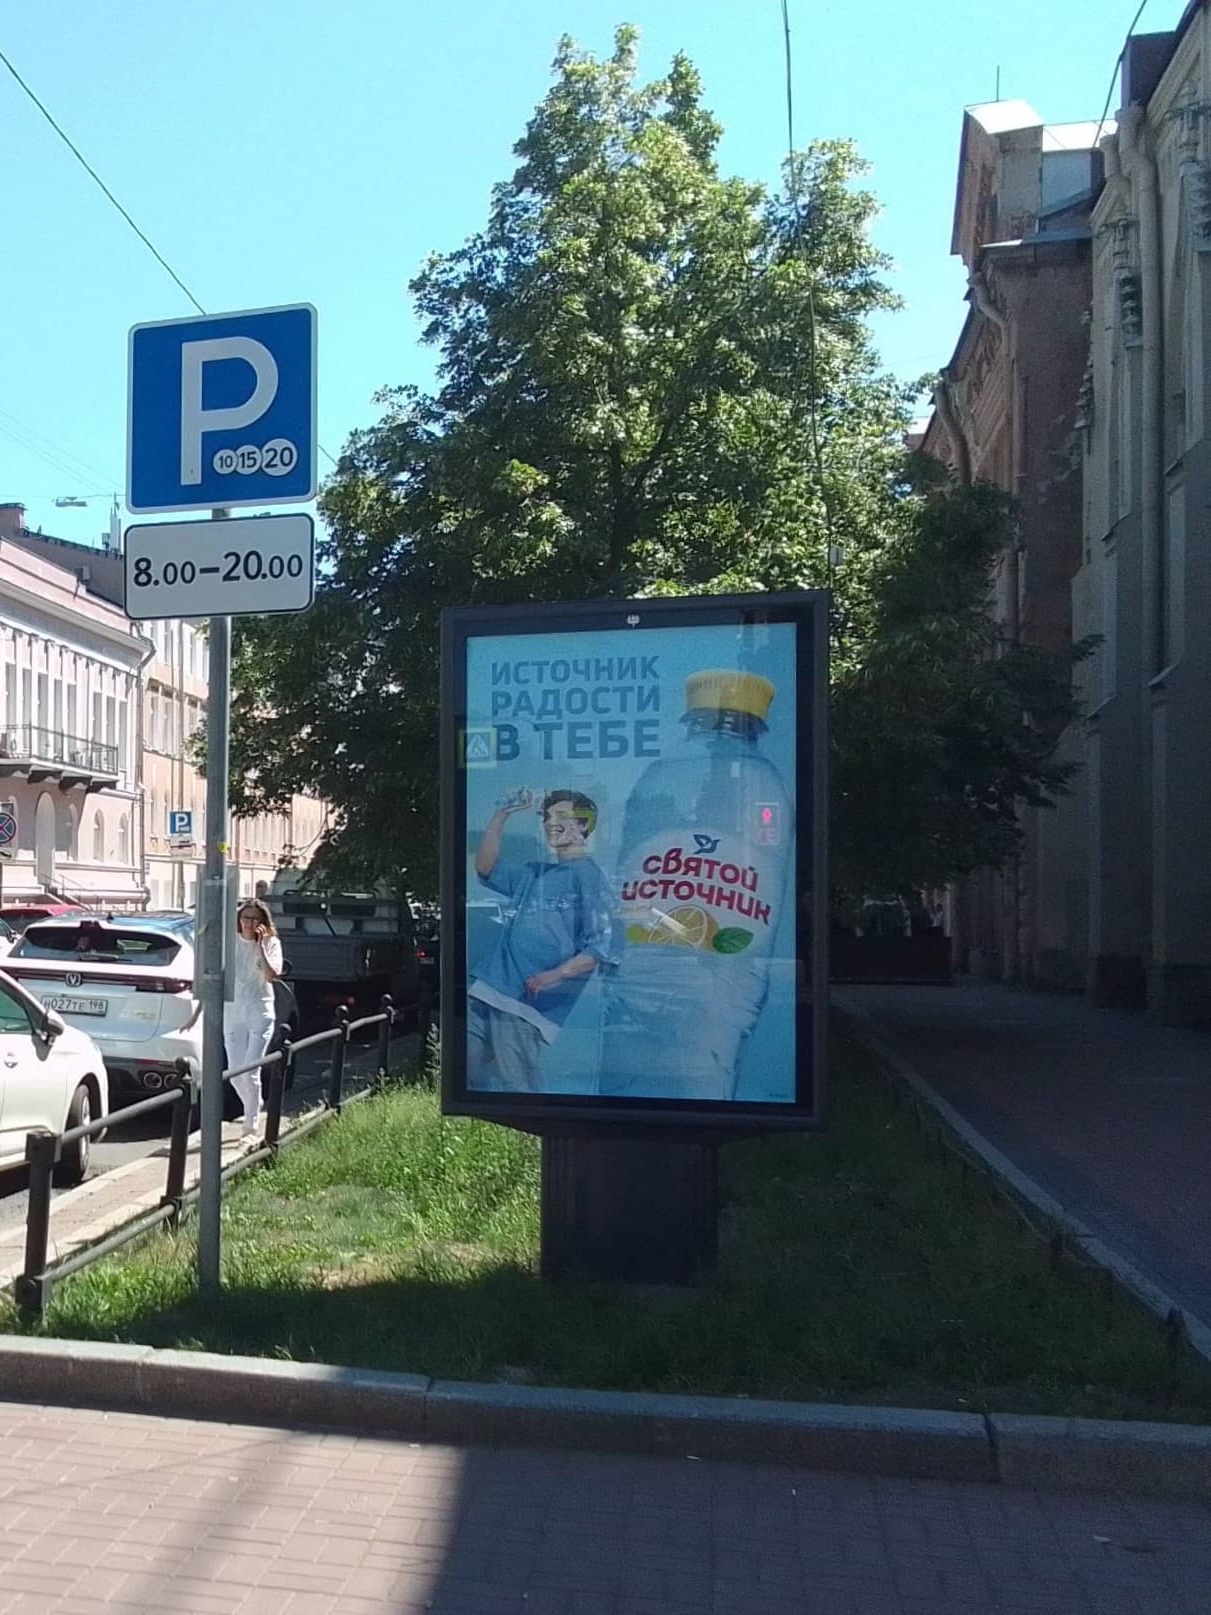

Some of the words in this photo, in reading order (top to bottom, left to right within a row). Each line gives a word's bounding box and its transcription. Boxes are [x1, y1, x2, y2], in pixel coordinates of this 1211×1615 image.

[181, 336, 279, 486] P
[219, 455, 233, 469] 10
[239, 451, 257, 469] 15
[264, 447, 293, 469] 20
[491, 655, 661, 686] ИСТОЧНИК
[491, 684, 661, 721] РАДОСТИ
[492, 723, 521, 761] В
[532, 719, 661, 761] ТЕБЕ
[175, 813, 189, 832] P
